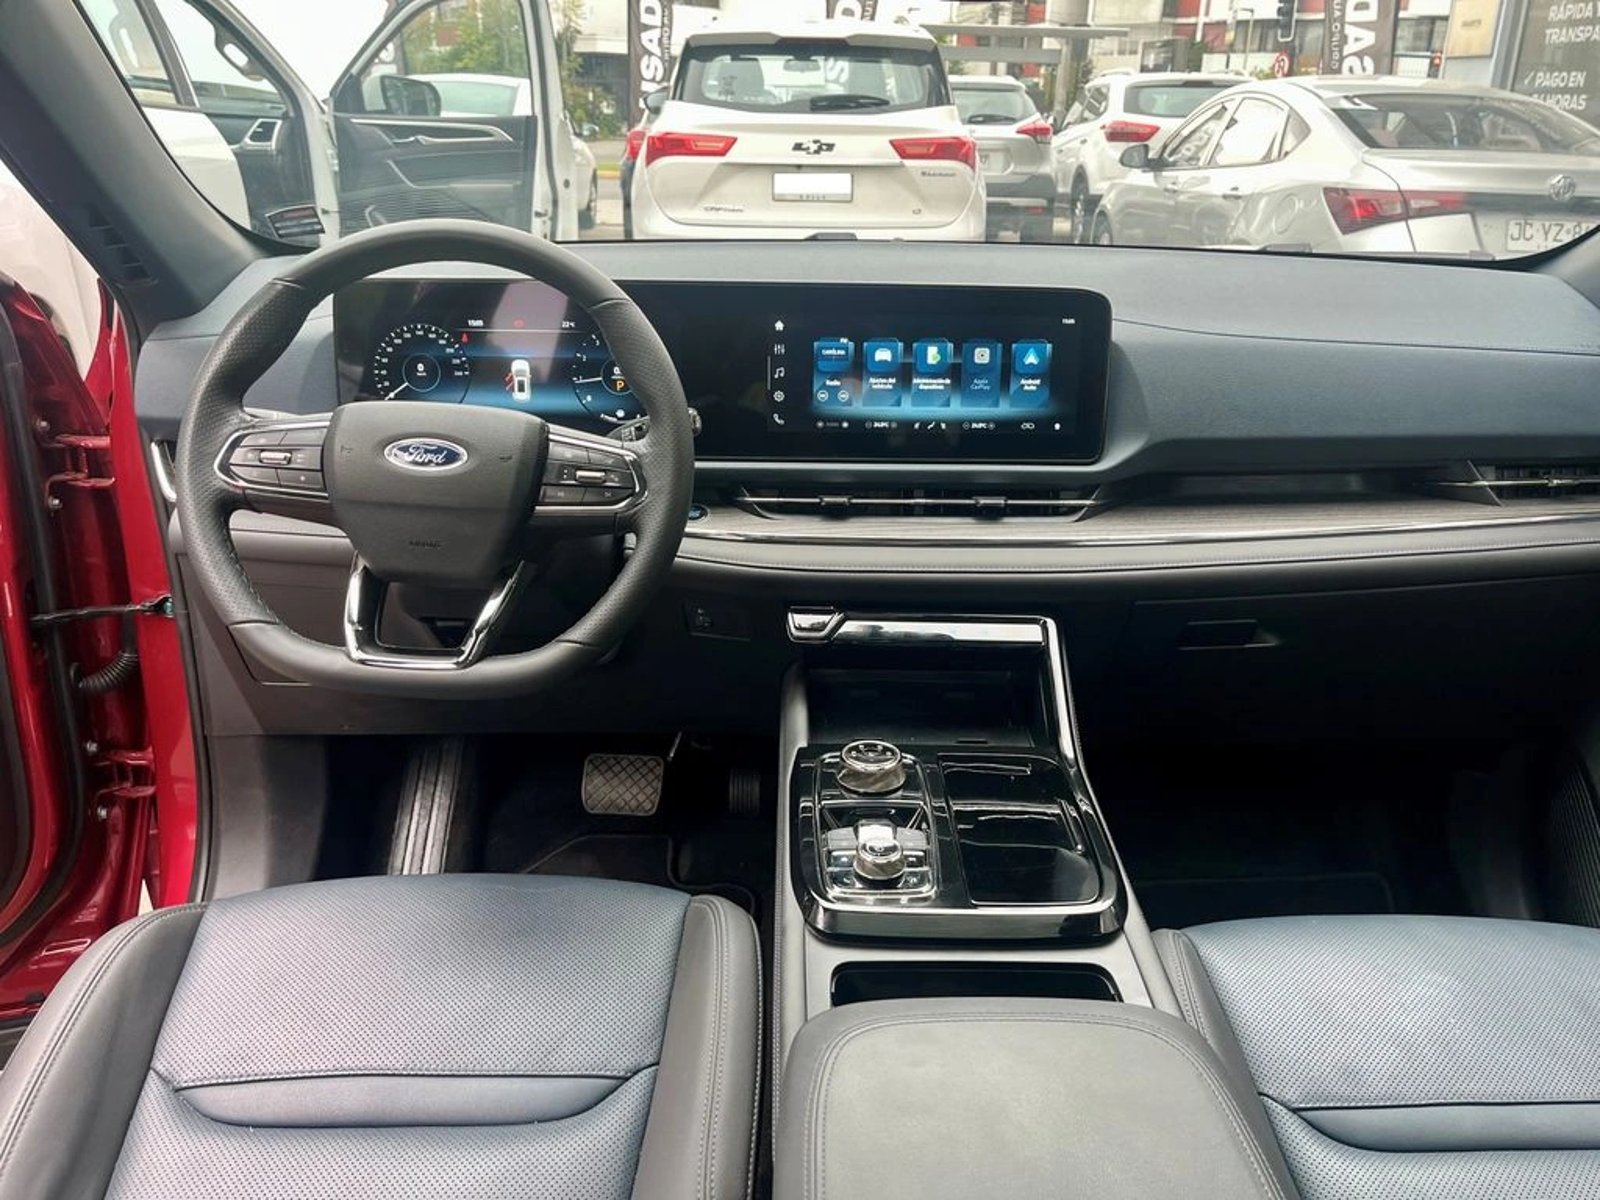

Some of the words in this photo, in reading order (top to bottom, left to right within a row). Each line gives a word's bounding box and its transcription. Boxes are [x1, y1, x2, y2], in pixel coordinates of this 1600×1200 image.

[1545, 25, 1600, 45] TRANSPA
[1535, 71, 1568, 88] PAGO
[1568, 70, 1587, 88] EN
[390, 443, 448, 464] Ford
